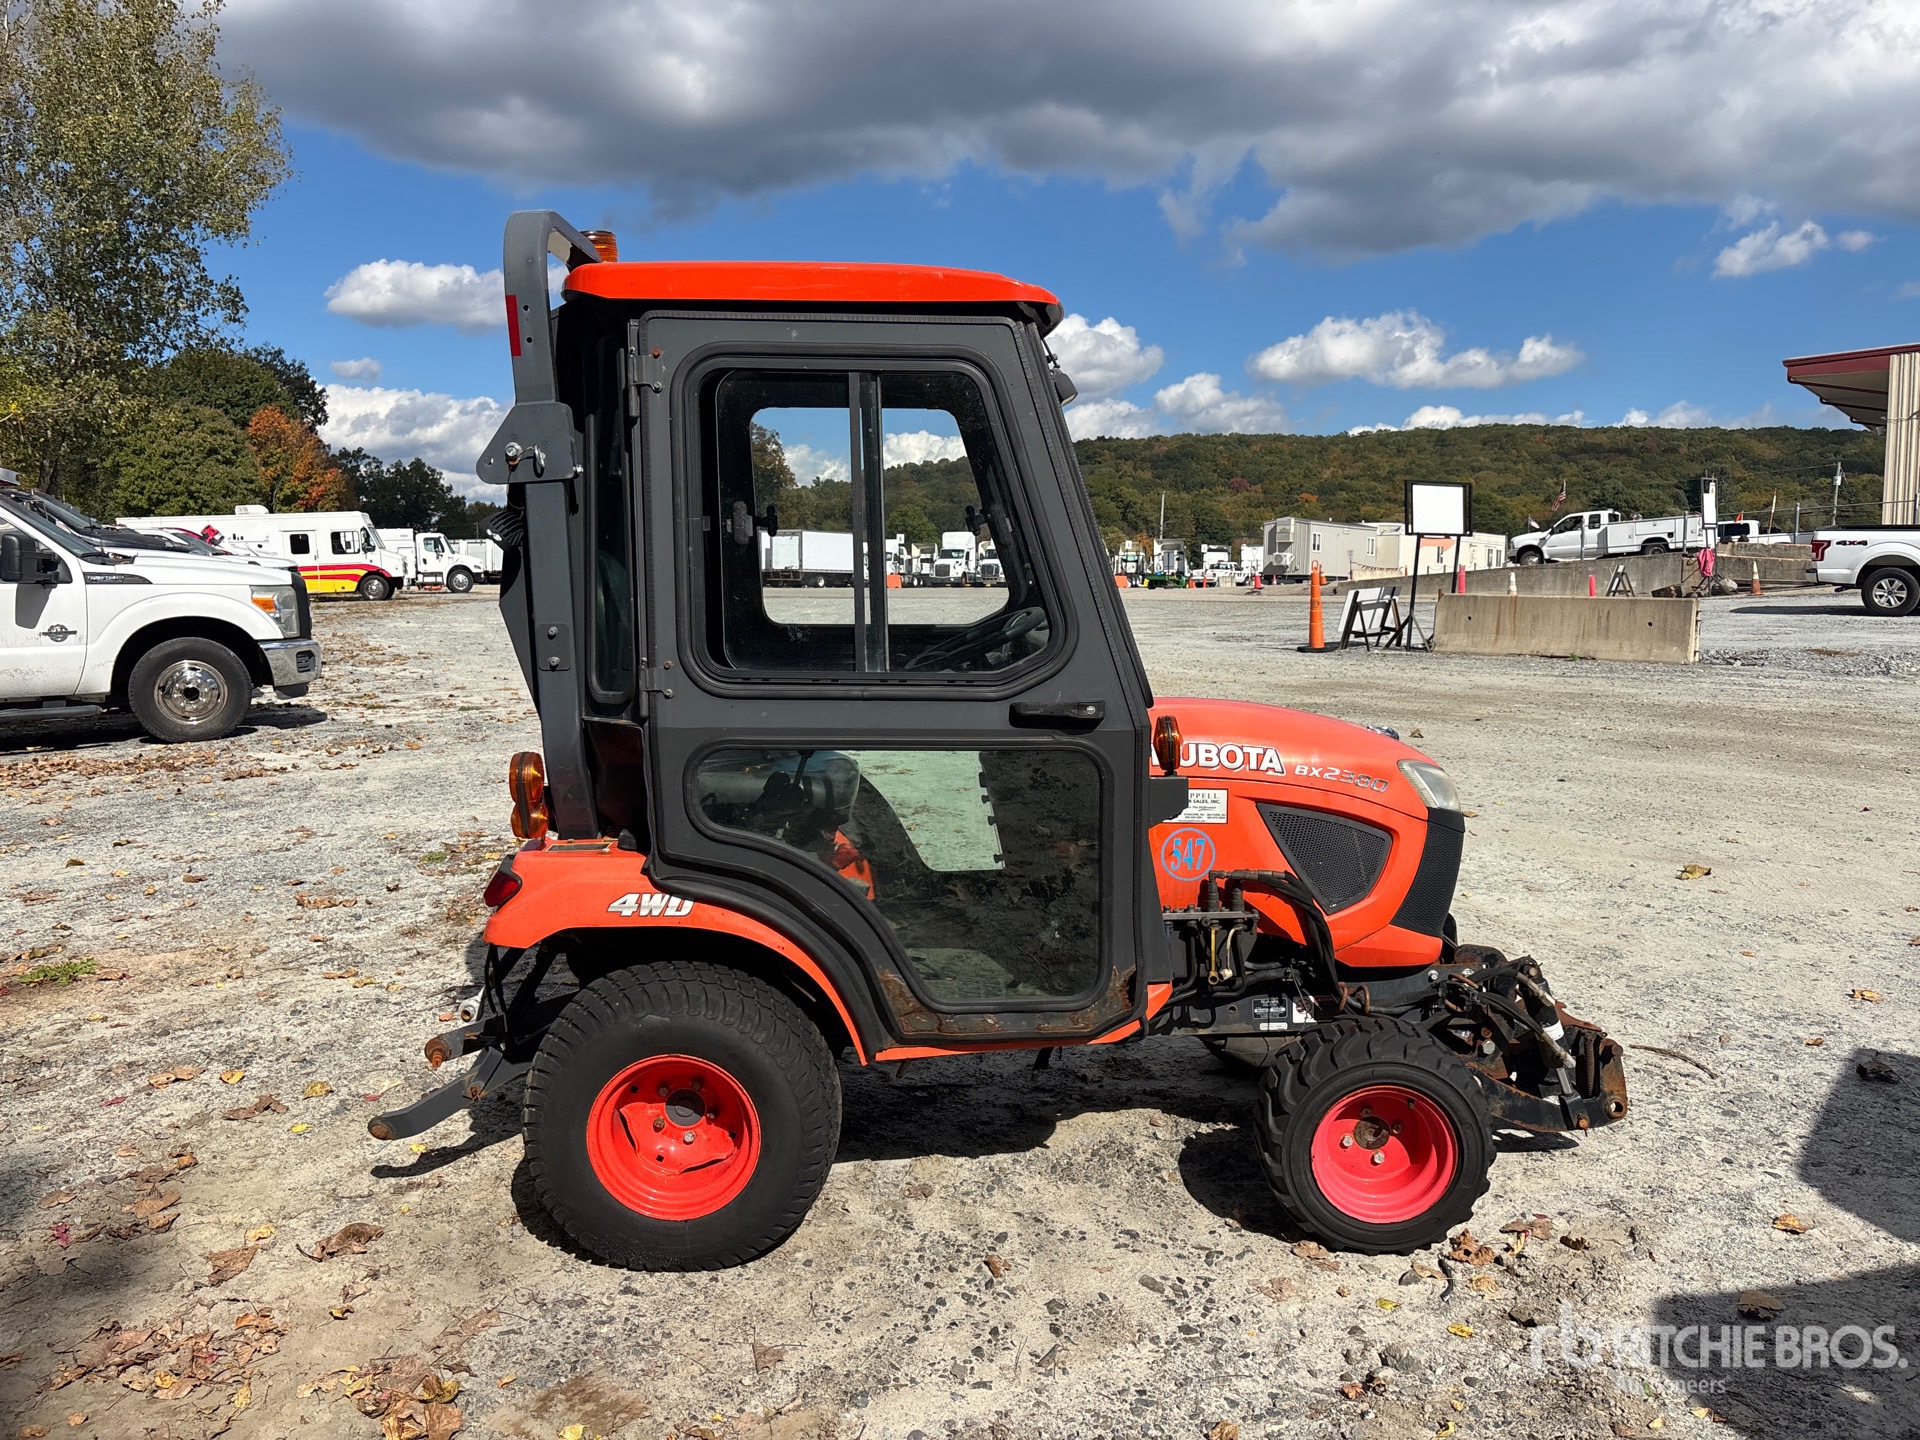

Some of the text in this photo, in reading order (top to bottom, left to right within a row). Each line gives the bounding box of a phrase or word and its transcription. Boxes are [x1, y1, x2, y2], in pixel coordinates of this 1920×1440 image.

[1294, 764, 1389, 793] BX2380
[1171, 838, 1205, 870] 547
[606, 892, 695, 917] 4WD
